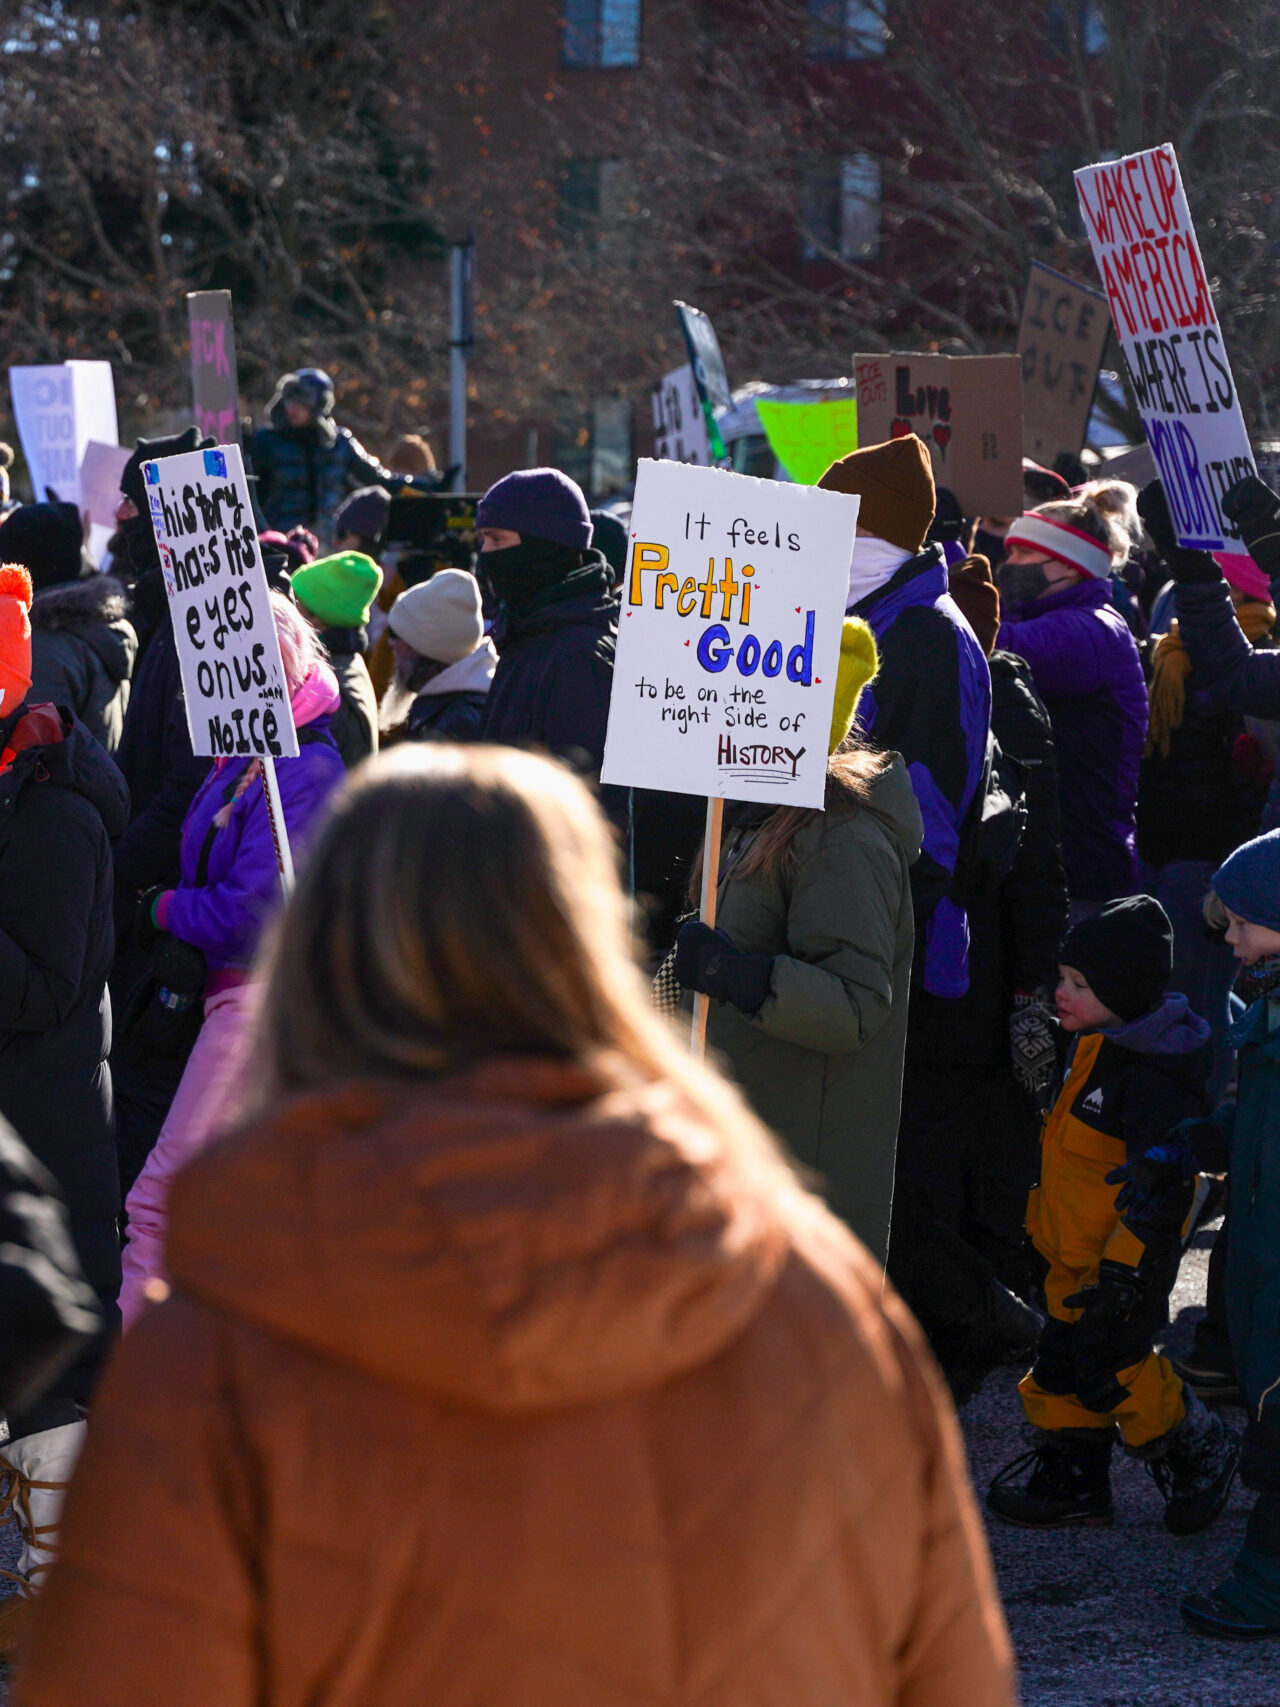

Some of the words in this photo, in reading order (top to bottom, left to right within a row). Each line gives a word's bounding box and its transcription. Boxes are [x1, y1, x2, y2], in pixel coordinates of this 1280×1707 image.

[1076, 159, 1156, 244] WAKE
[1140, 149, 1180, 233] UP
[1028, 283, 1096, 340] ICE
[1101, 230, 1217, 340] AMERICA
[1120, 334, 1201, 414] WHERE
[1186, 328, 1234, 413] IS
[158, 481, 245, 538] history
[1141, 417, 1221, 536] YOUR
[685, 512, 712, 541] It
[726, 517, 801, 551] feels
[186, 581, 255, 650] eyes
[628, 542, 756, 626] Pretti
[696, 610, 817, 688] Good
[634, 676, 658, 700] to
[664, 677, 686, 700] be
[697, 686, 719, 703] on
[729, 684, 767, 705] the
[661, 703, 712, 734] right
[779, 713, 807, 732] of
[717, 733, 807, 778] HISTORY
